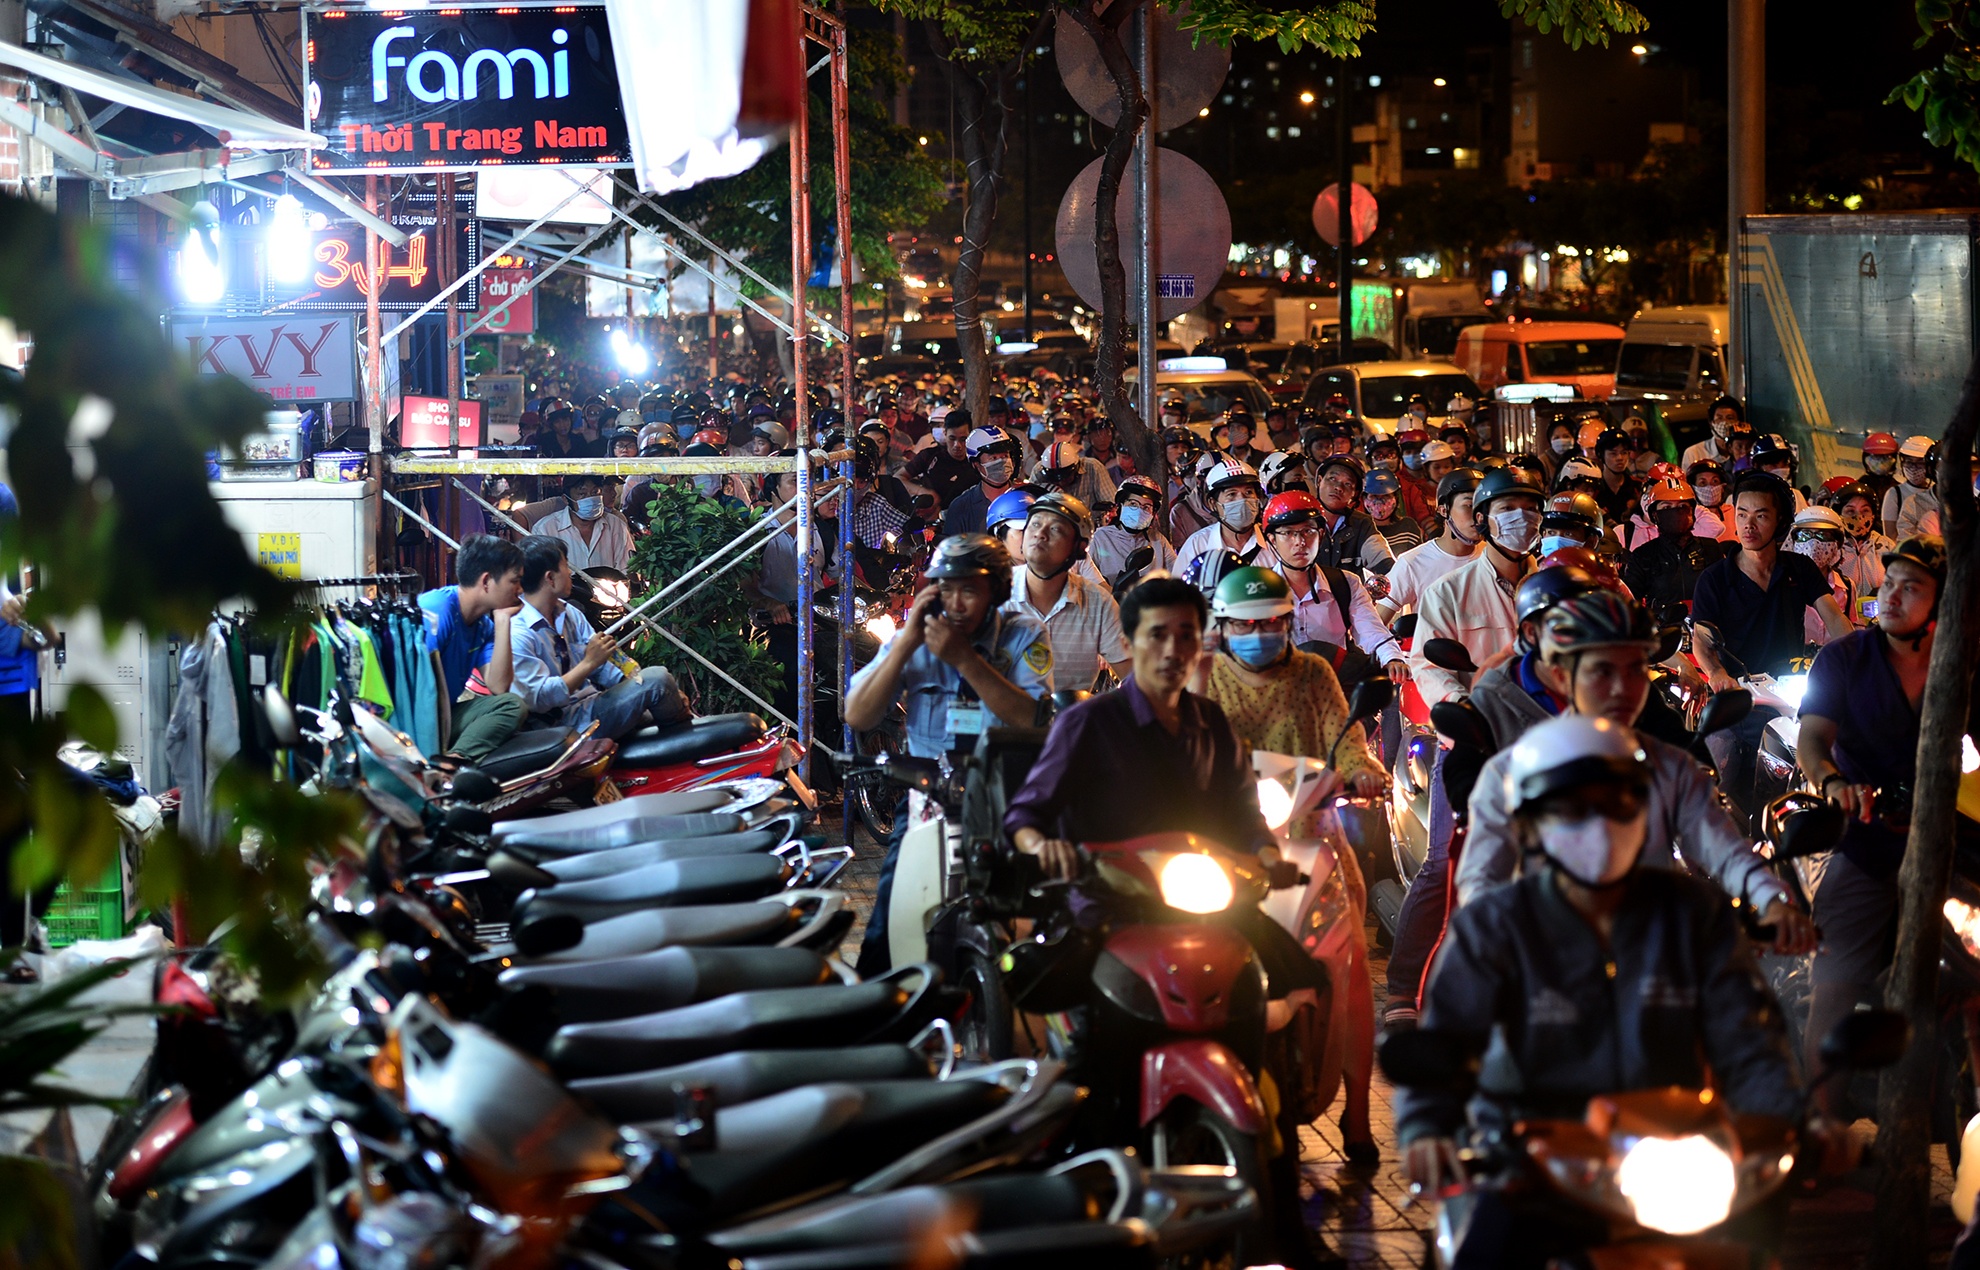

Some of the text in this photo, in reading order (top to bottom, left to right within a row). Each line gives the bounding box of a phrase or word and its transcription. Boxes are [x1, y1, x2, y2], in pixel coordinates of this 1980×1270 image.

[341, 120, 607, 155] Thời Trang Nam
[296, 386, 317, 398] EM
[277, 566, 283, 577] 4
